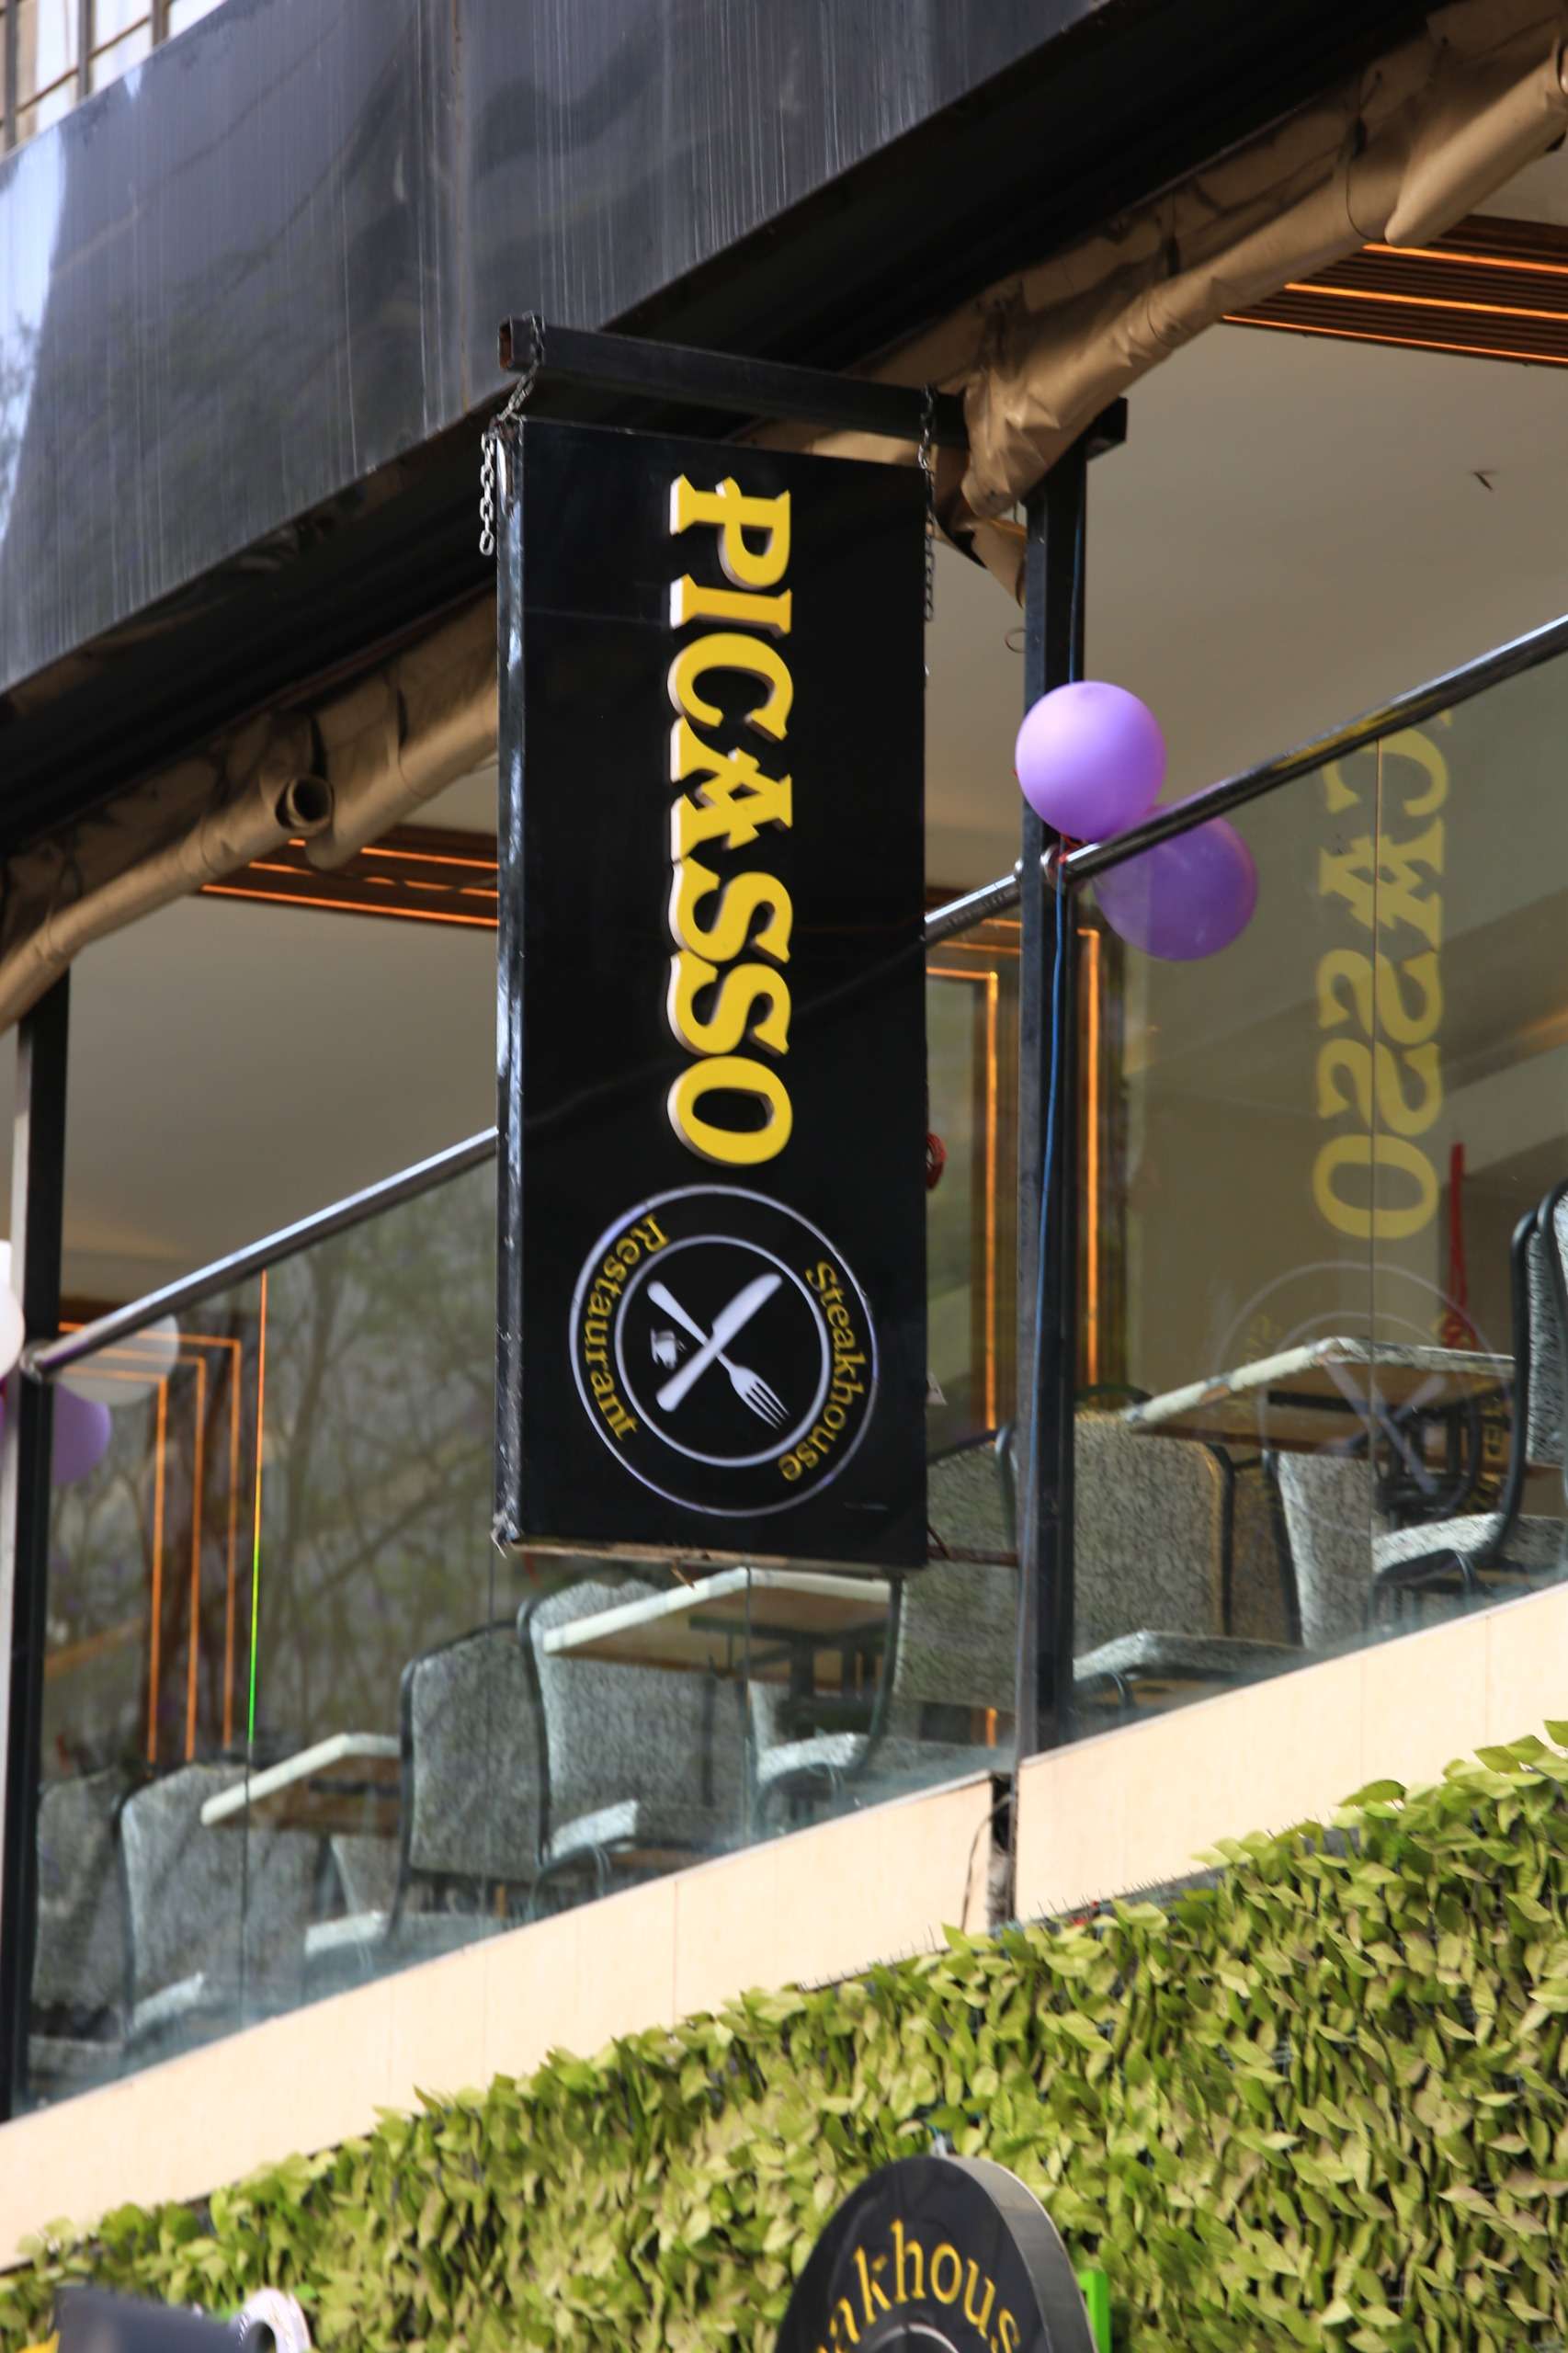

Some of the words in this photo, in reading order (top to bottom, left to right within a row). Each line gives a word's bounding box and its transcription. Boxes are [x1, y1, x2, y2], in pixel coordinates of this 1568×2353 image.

[668, 474, 794, 1165] PICASSO
[584, 1213, 669, 1442] Restaurant
[778, 1260, 867, 1483] Steakhouse
[816, 2217, 1021, 2353] akhous
